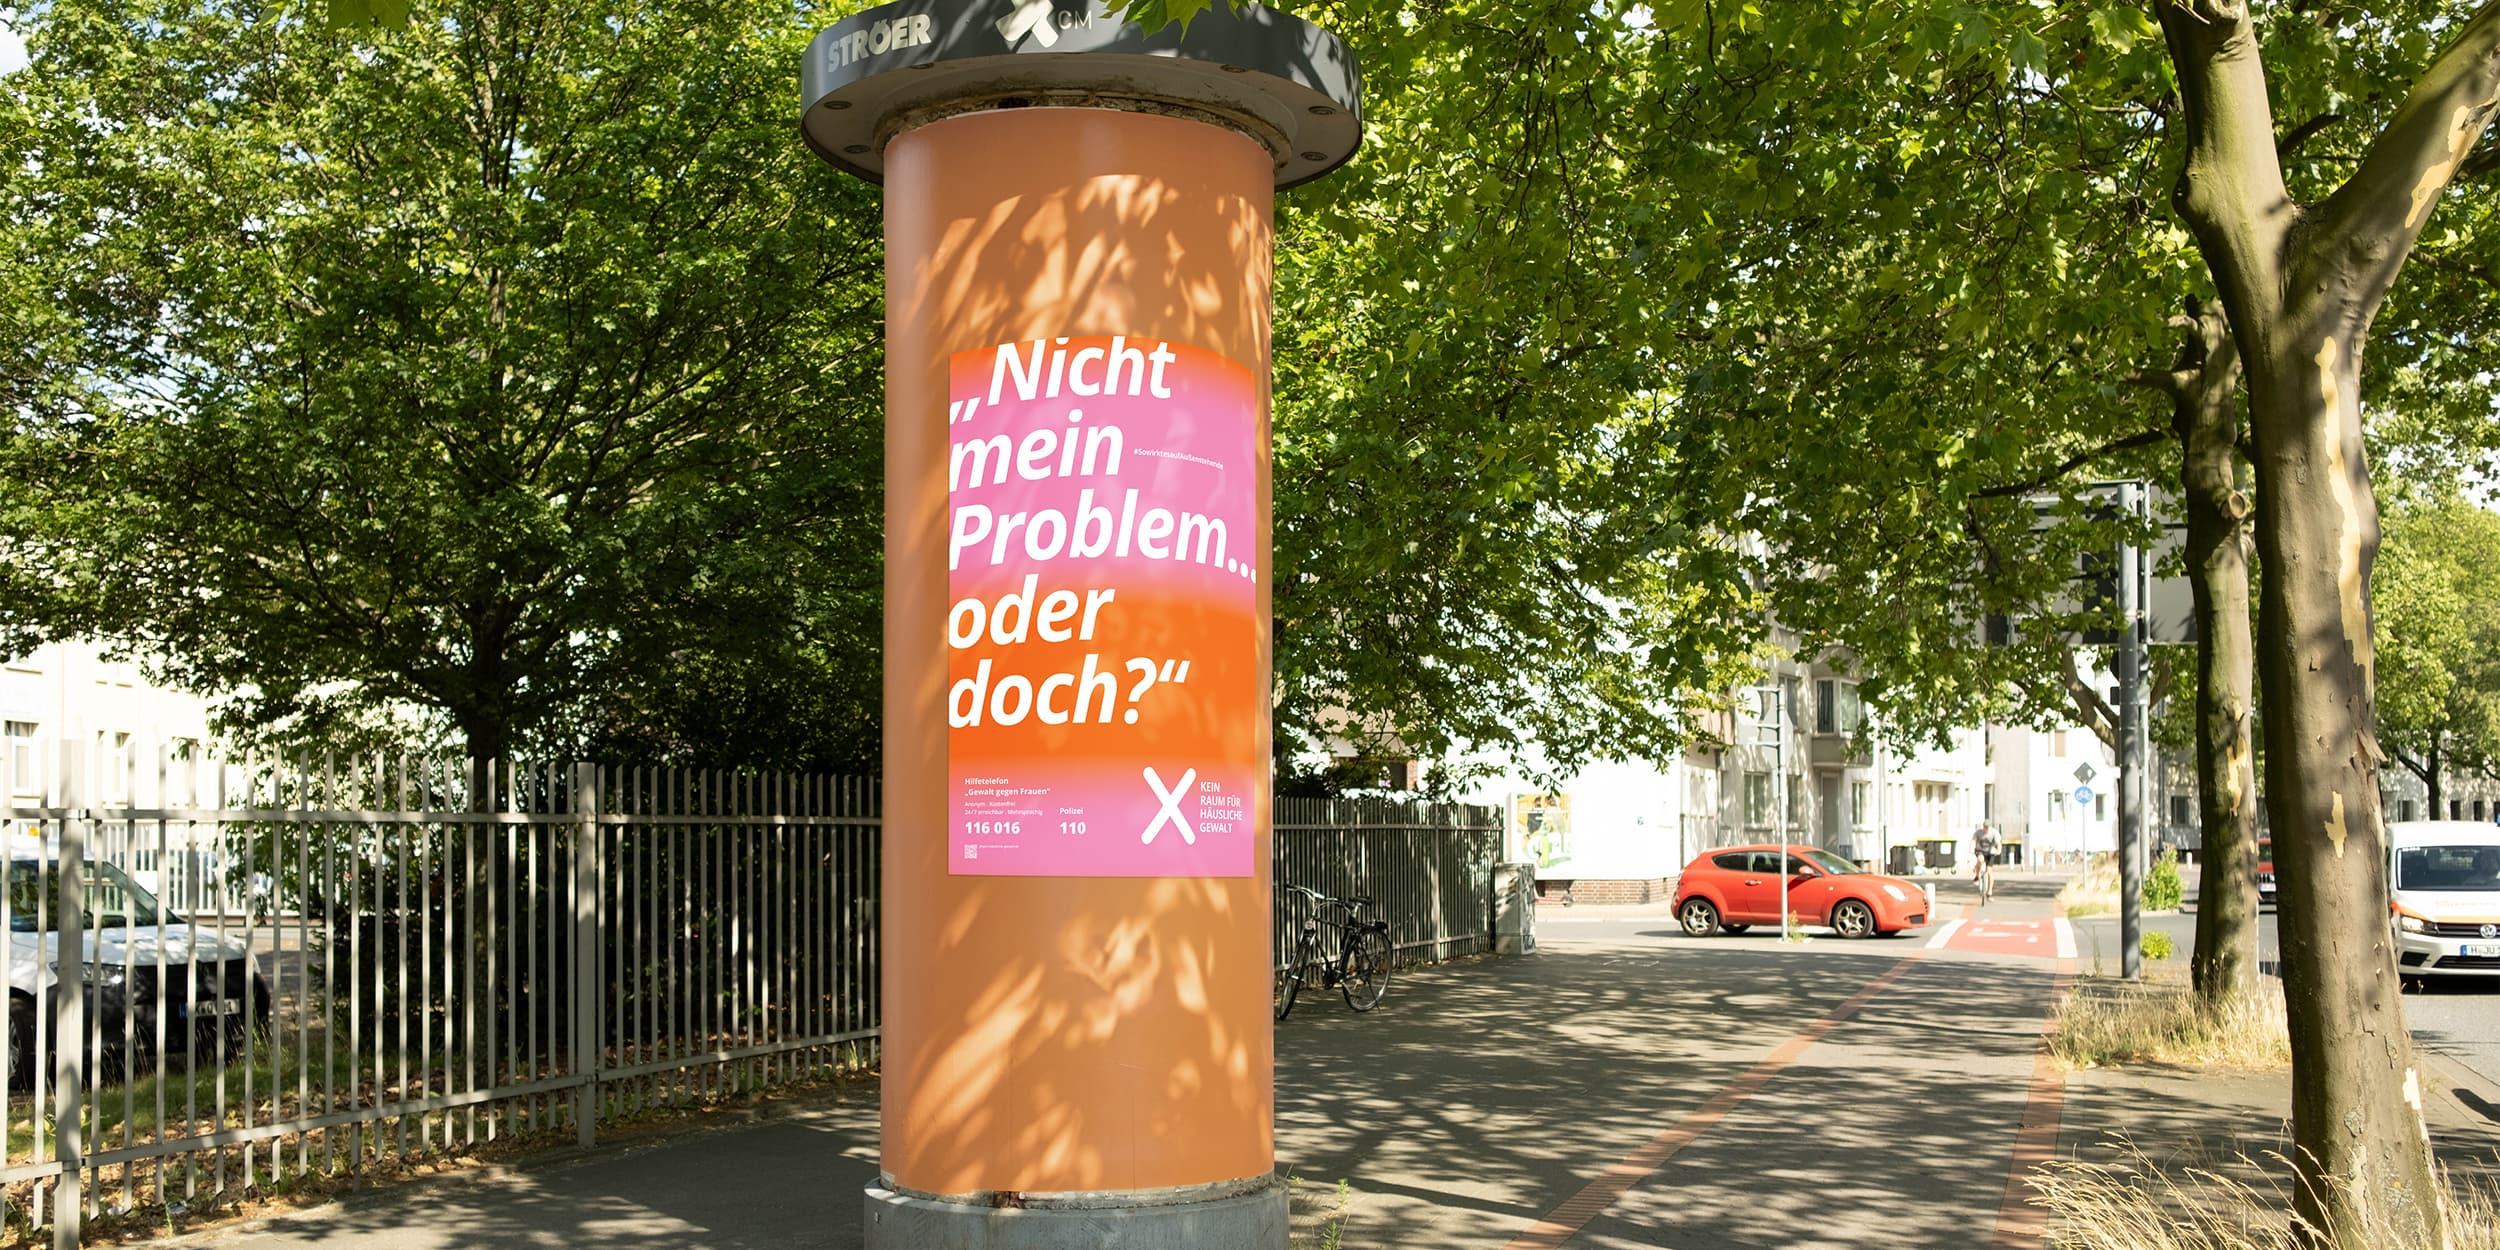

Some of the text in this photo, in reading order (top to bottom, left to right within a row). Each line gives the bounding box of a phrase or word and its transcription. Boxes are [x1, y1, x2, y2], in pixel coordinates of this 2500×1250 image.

[1057, 9, 1092, 30] CM
[828, 13, 932, 73] STRÖER
[950, 335, 1176, 425] „Nicht
[950, 409, 1124, 492] mein
[950, 488, 1256, 583] Problem...
[949, 573, 1116, 649] oder
[949, 653, 1191, 729] doch?“
[964, 777, 1009, 785] Hilfetelefon
[1200, 781, 1221, 792] KEIN
[965, 787, 995, 797] „Gewalt
[995, 789, 1019, 797] gegen
[1200, 794, 1241, 808] RAUM FÜR
[1059, 807, 1084, 815] Polizei
[1200, 807, 1243, 821] HÄUSLICHE
[965, 821, 1021, 835] 116 016
[1060, 821, 1087, 835] 110
[1200, 822, 1233, 834] GEWALT
